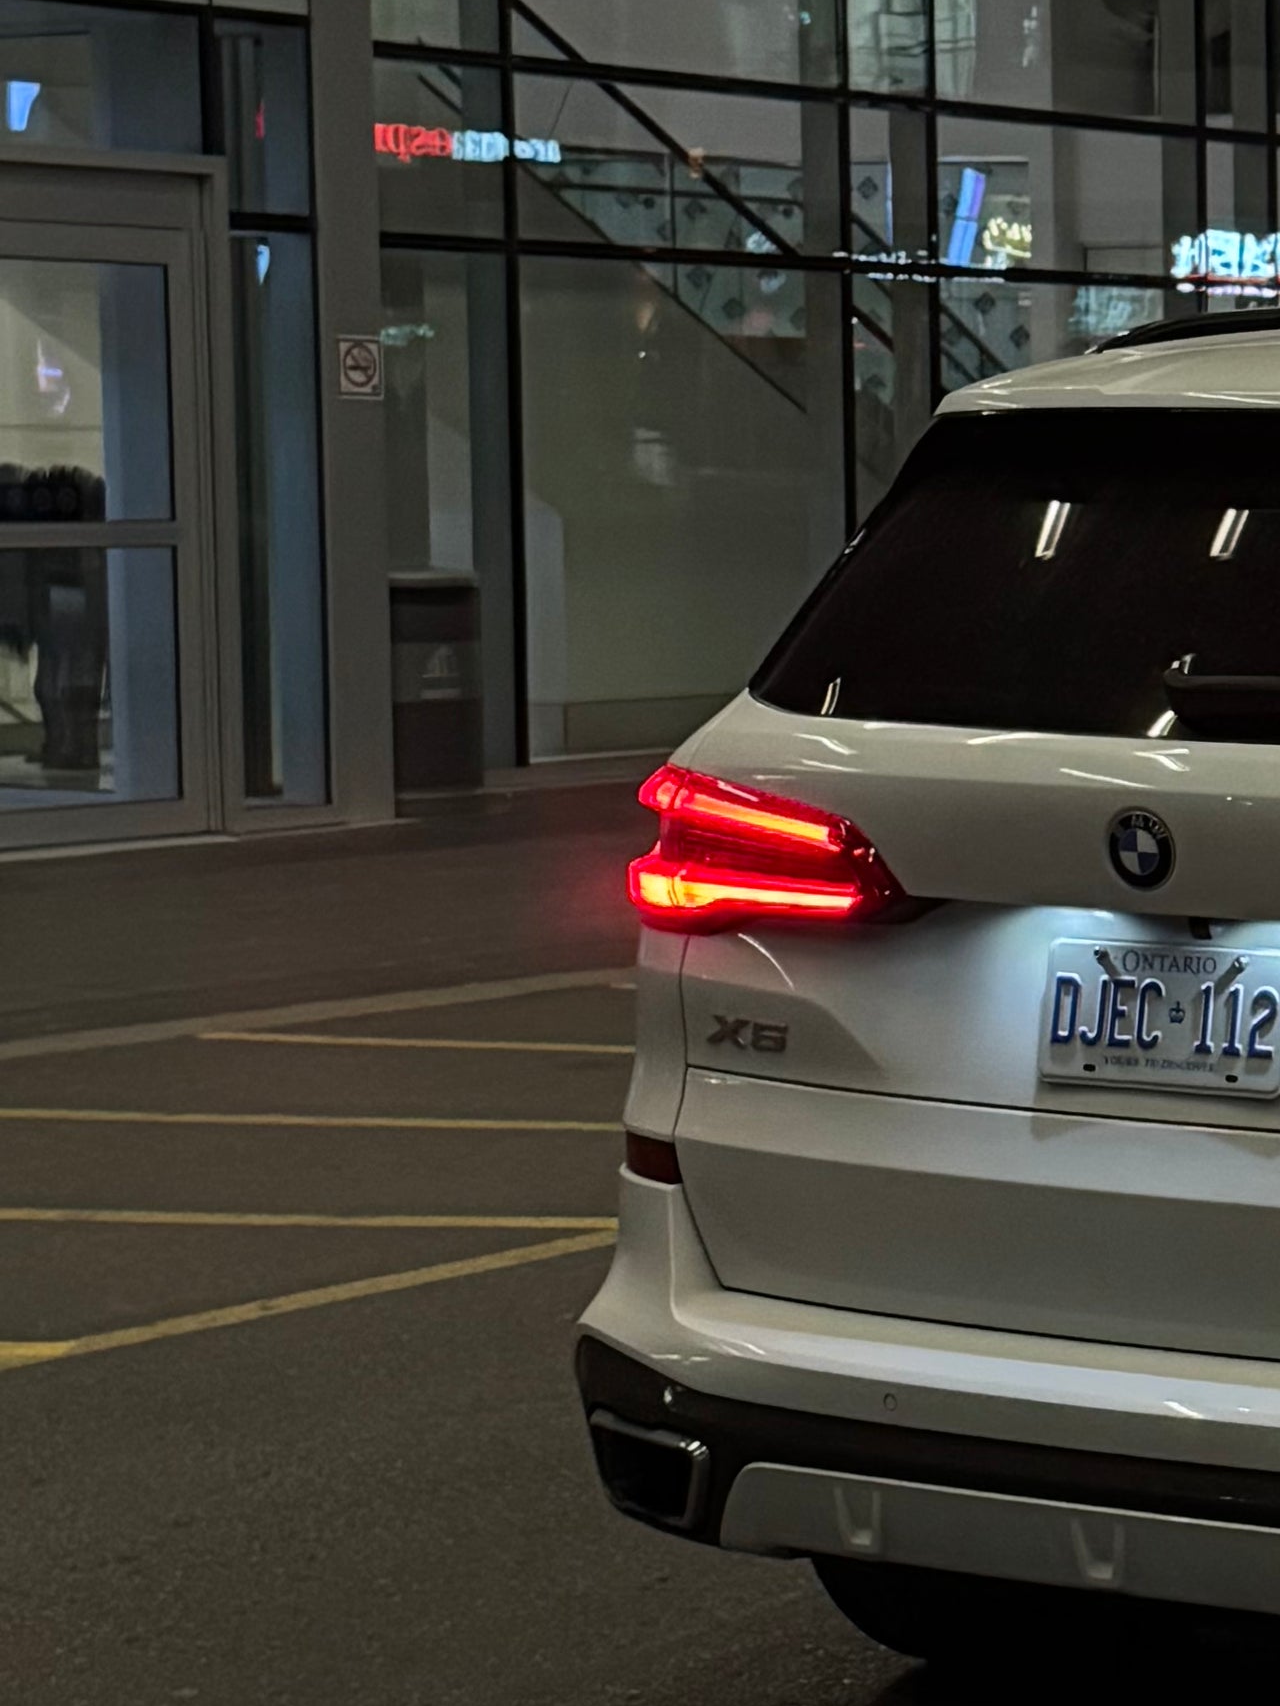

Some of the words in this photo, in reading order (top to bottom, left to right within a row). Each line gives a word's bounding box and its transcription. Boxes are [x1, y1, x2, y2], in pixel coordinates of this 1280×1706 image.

[1122, 949, 1217, 975] ONTARIO
[1051, 972, 1166, 1050] DJEC
[1193, 980, 1280, 1060] 112
